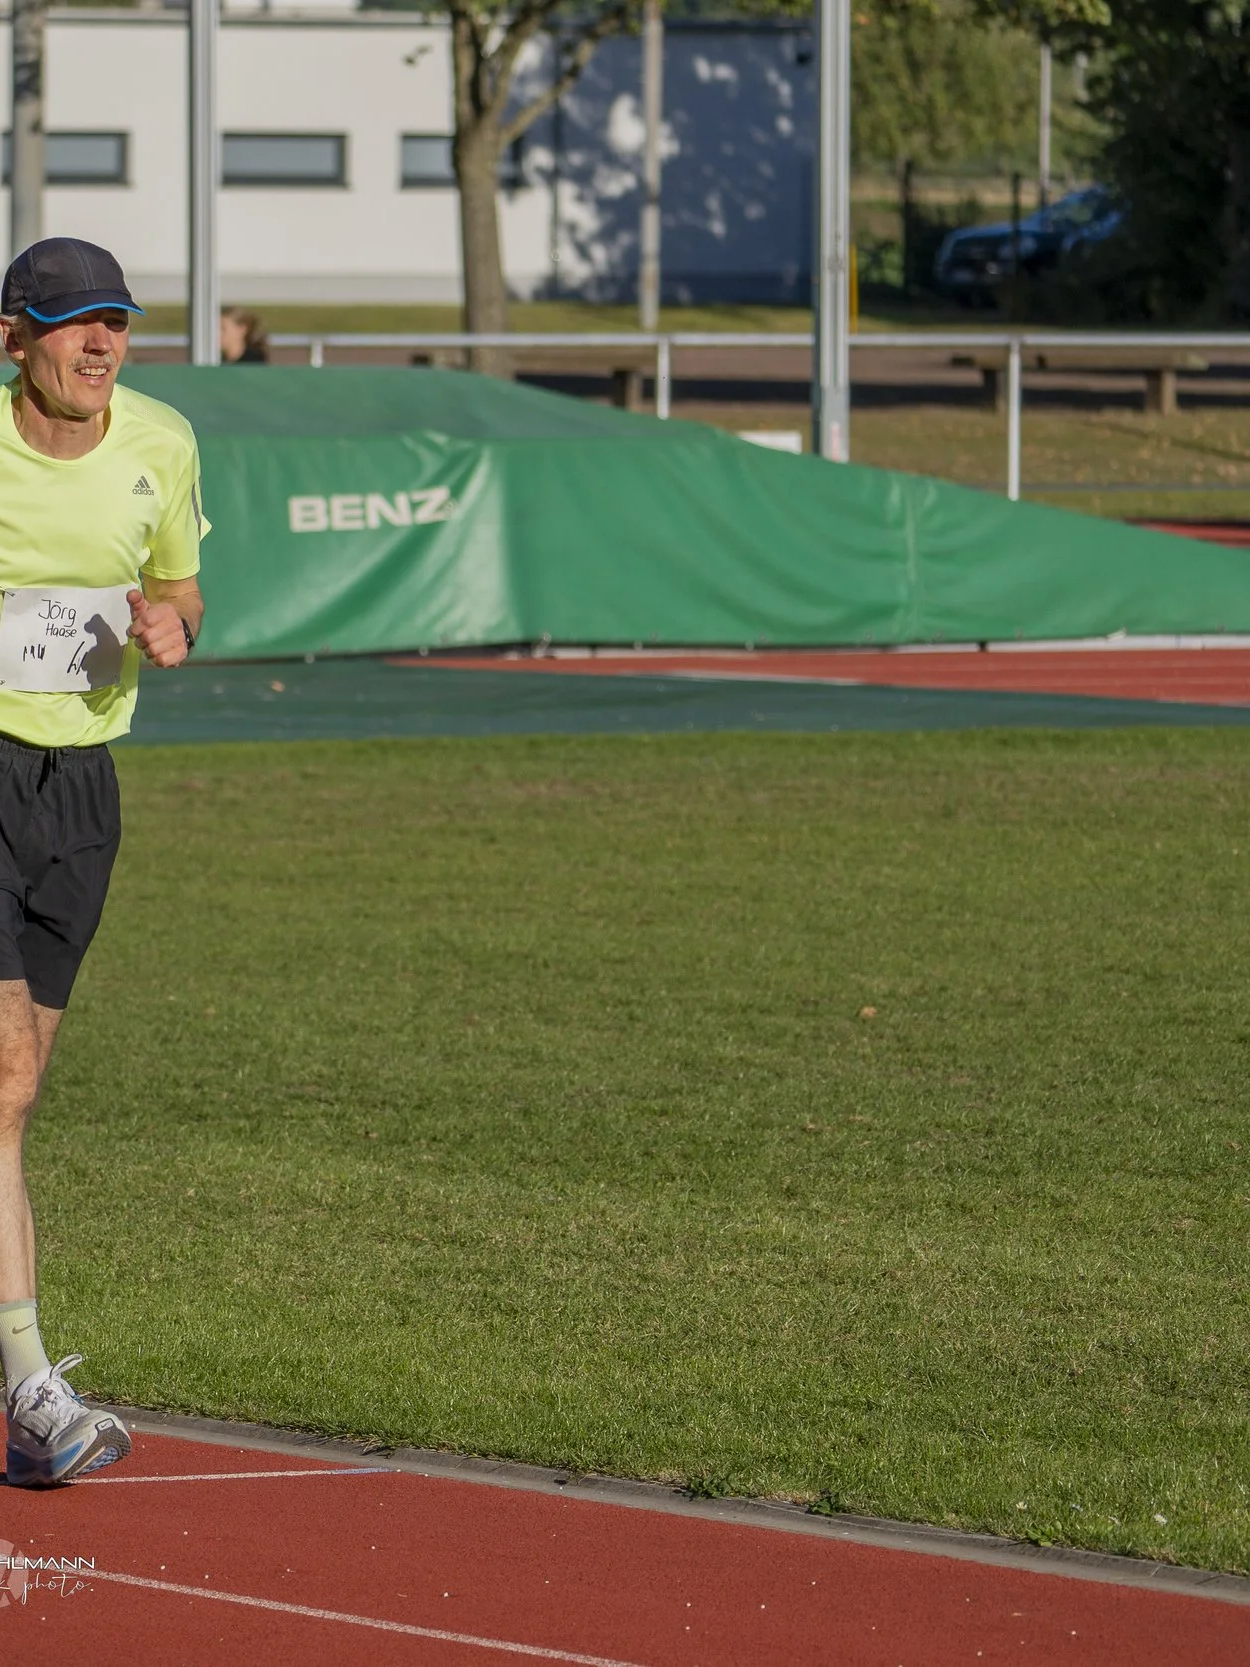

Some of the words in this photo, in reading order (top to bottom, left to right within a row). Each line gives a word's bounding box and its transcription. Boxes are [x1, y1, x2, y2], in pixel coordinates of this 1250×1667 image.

[132, 487, 154, 496] adidas
[288, 486, 450, 533] BENZ
[38, 599, 77, 627] Jörg
[45, 622, 78, 638] Haase
